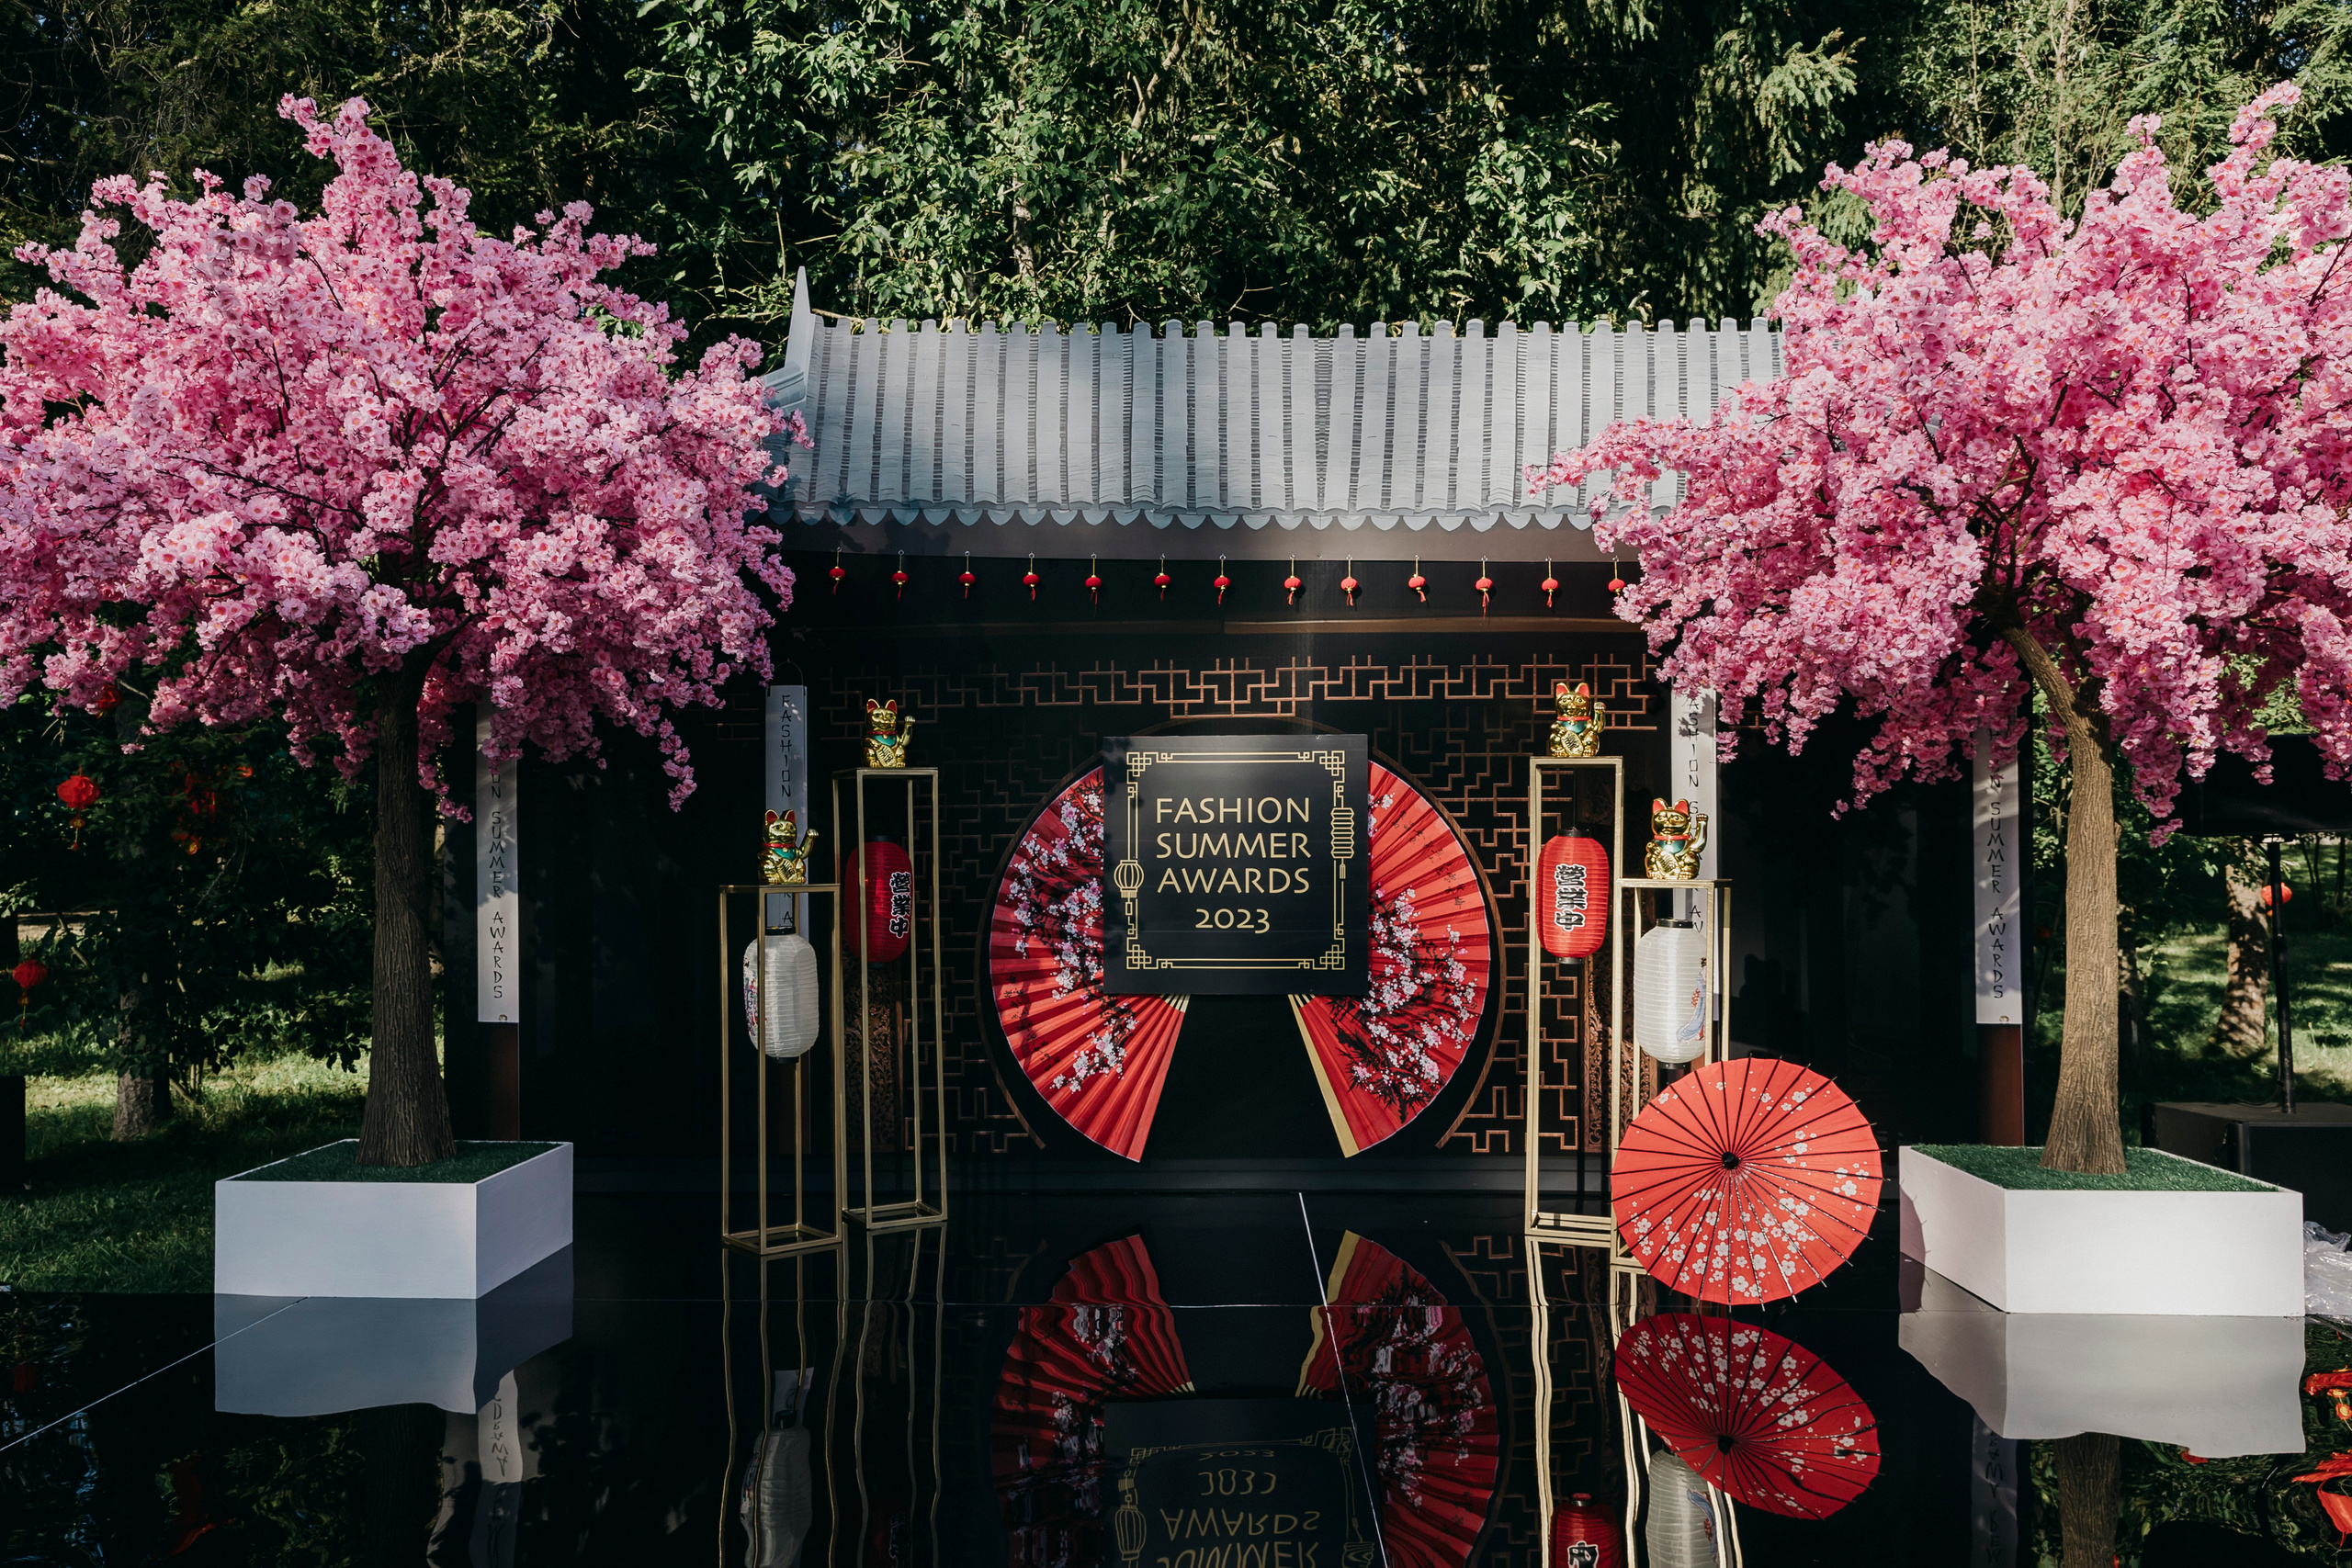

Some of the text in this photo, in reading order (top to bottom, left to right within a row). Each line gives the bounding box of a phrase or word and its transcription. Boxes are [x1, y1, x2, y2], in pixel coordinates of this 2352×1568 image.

[780, 694, 792, 797] FASHION
[1688, 698, 1700, 788] ASHION
[1156, 796, 1310, 824] FASHION
[1156, 832, 1312, 859] SUMMER
[1987, 802, 2005, 893] SUMMER
[489, 811, 504, 898] SUMMER
[1157, 867, 1310, 894] AWARDS
[490, 911, 505, 998] AWARDS
[1195, 908, 1271, 934] 2023
[1988, 907, 2006, 998] AWARDS
